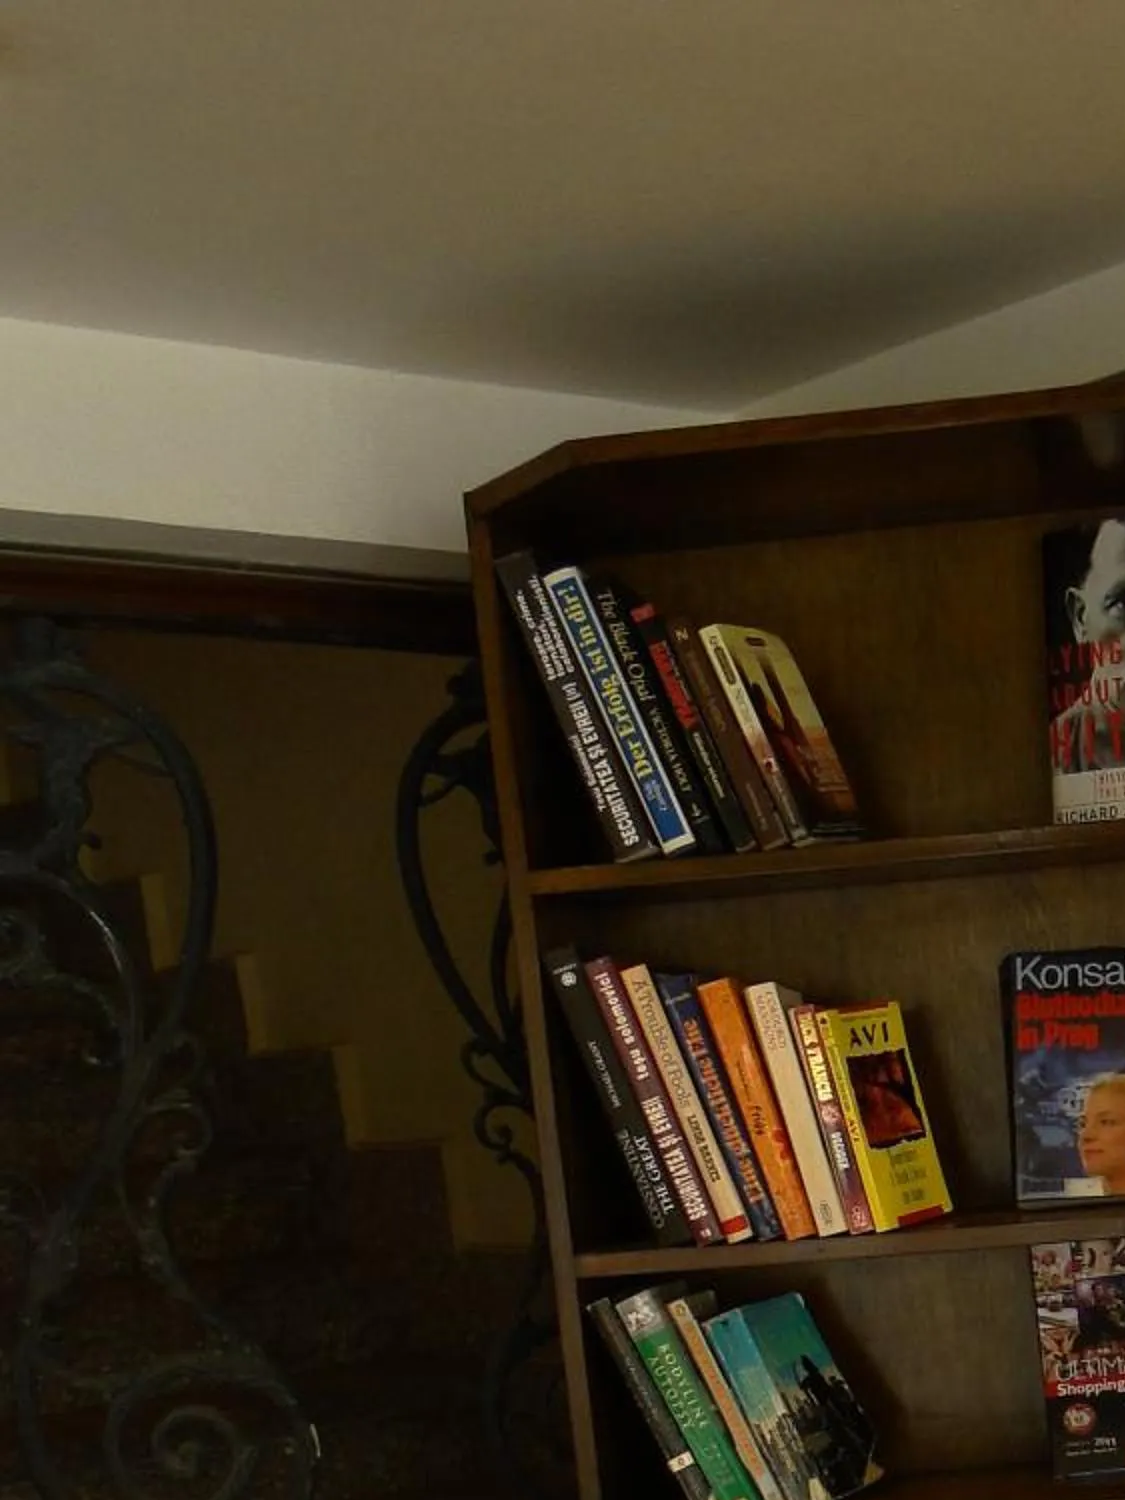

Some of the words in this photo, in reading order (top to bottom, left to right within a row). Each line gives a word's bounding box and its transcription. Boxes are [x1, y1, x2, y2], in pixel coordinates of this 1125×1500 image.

[555, 584, 587, 627] dir!
[595, 588, 620, 620] The
[573, 624, 597, 649] in
[607, 618, 639, 664] Black
[1050, 640, 1122, 675] YING
[583, 646, 610, 676] ist
[623, 659, 656, 704] Opal
[595, 673, 641, 740] Erfolg
[585, 740, 609, 760] ȘI
[648, 705, 679, 761] VICTORIA
[623, 738, 654, 779] Der
[591, 757, 640, 848] SECURITATEA
[631, 977, 647, 992] A
[594, 970, 636, 1047] solomovici
[635, 989, 672, 1053] Trouble
[797, 1012, 819, 1046] DICK
[850, 1021, 889, 1047] AVI
[660, 1049, 679, 1071] of
[805, 1045, 834, 1102] FRANCIS
[667, 1068, 693, 1107] Fools
[615, 1127, 666, 1231] CONSTANTINE
[632, 1131, 663, 1183] GREAT
[652, 1181, 676, 1216] THE
[661, 1144, 709, 1222] SECURITATEA
[646, 1352, 695, 1431] AUTOPSY
[656, 1340, 711, 1430] BODYLINE
